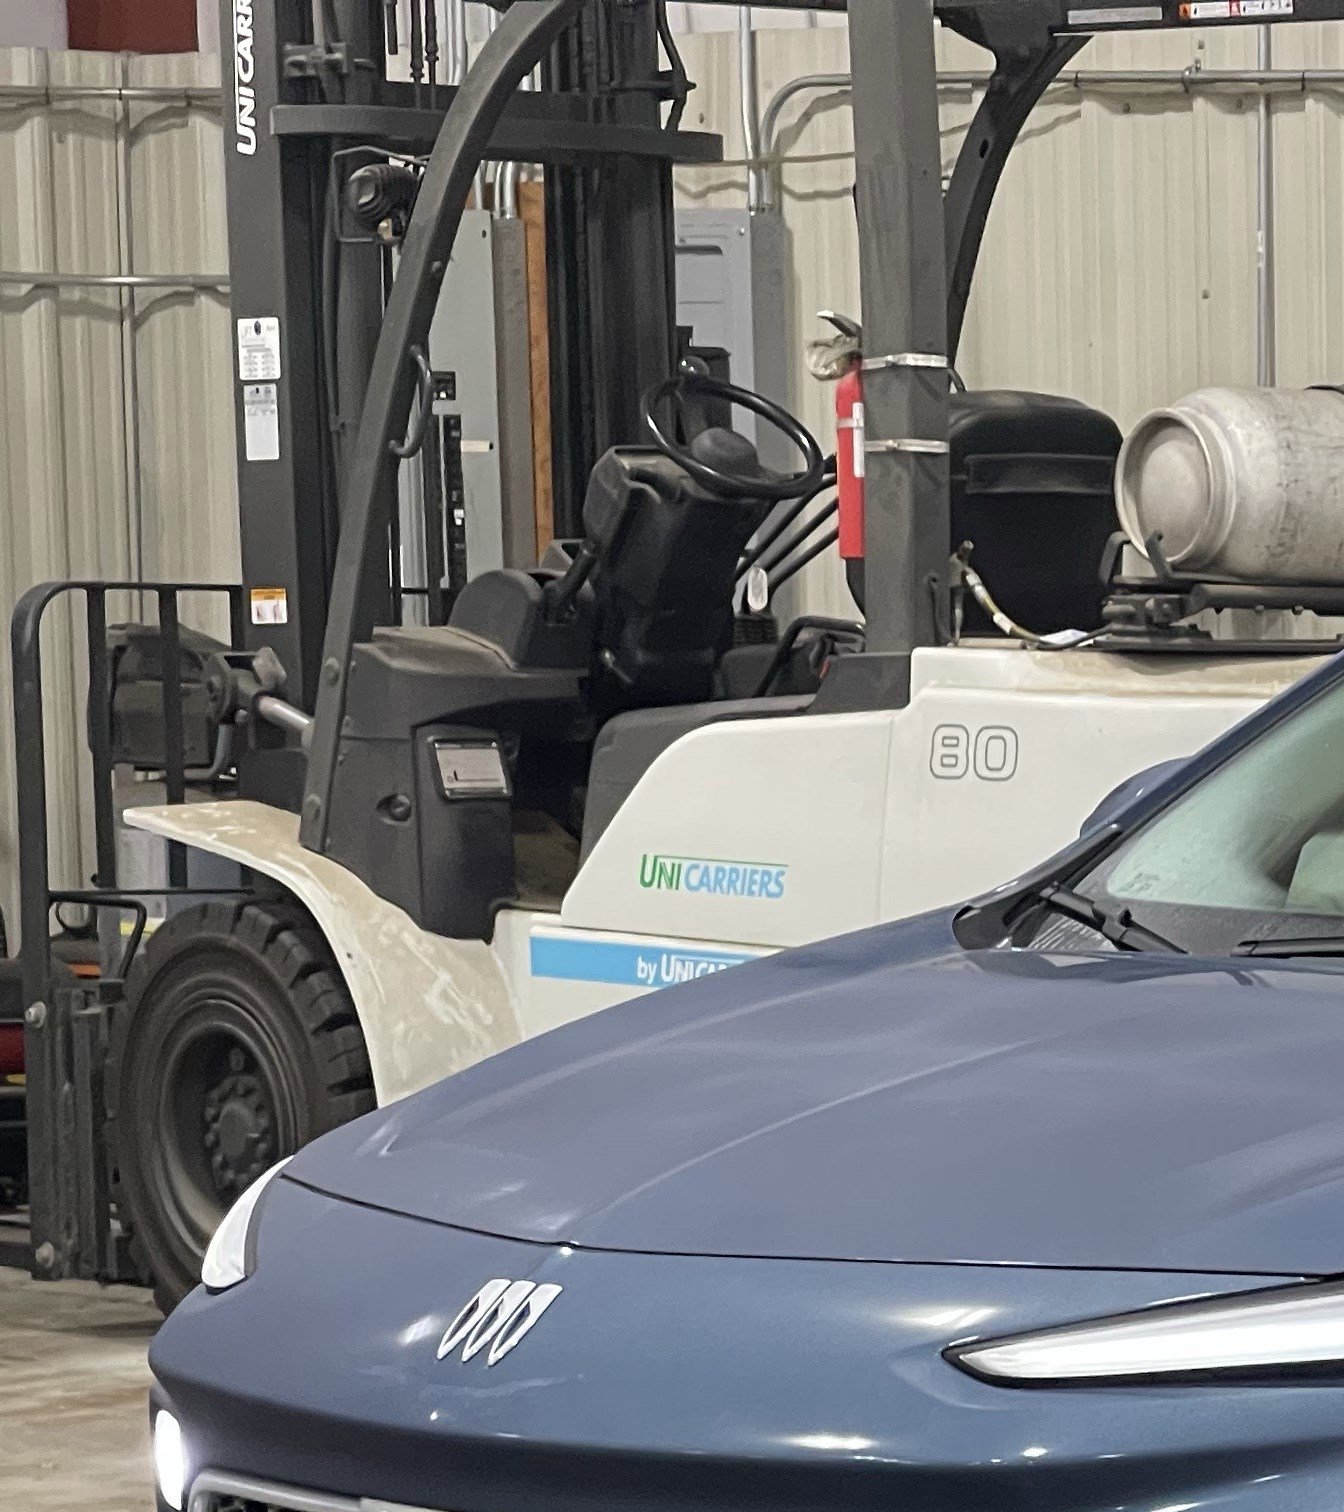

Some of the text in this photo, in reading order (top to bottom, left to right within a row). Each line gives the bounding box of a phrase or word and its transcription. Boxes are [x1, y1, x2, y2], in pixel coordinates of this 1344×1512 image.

[929, 723, 1019, 782] 80
[639, 853, 789, 899] UNICARRIERS
[637, 955, 658, 984] by
